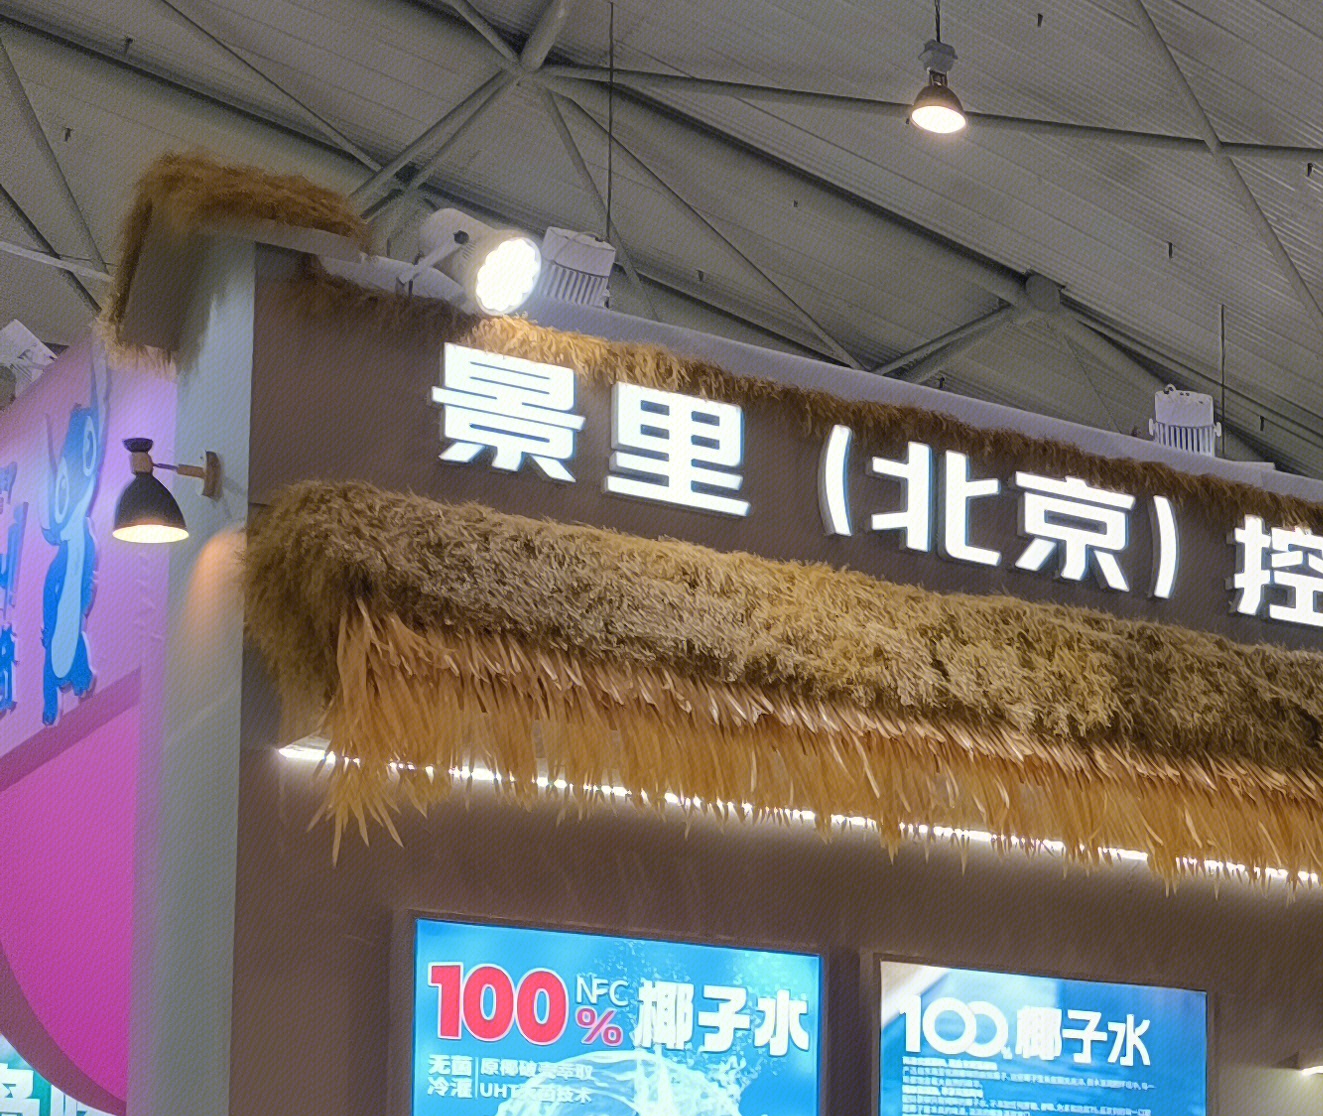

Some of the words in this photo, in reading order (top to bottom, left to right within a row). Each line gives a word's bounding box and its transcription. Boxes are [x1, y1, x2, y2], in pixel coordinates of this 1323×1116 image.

[575, 976, 629, 1007] NFC
[635, 979, 809, 1056] 椰子水
[428, 1054, 473, 1076] 无菌
